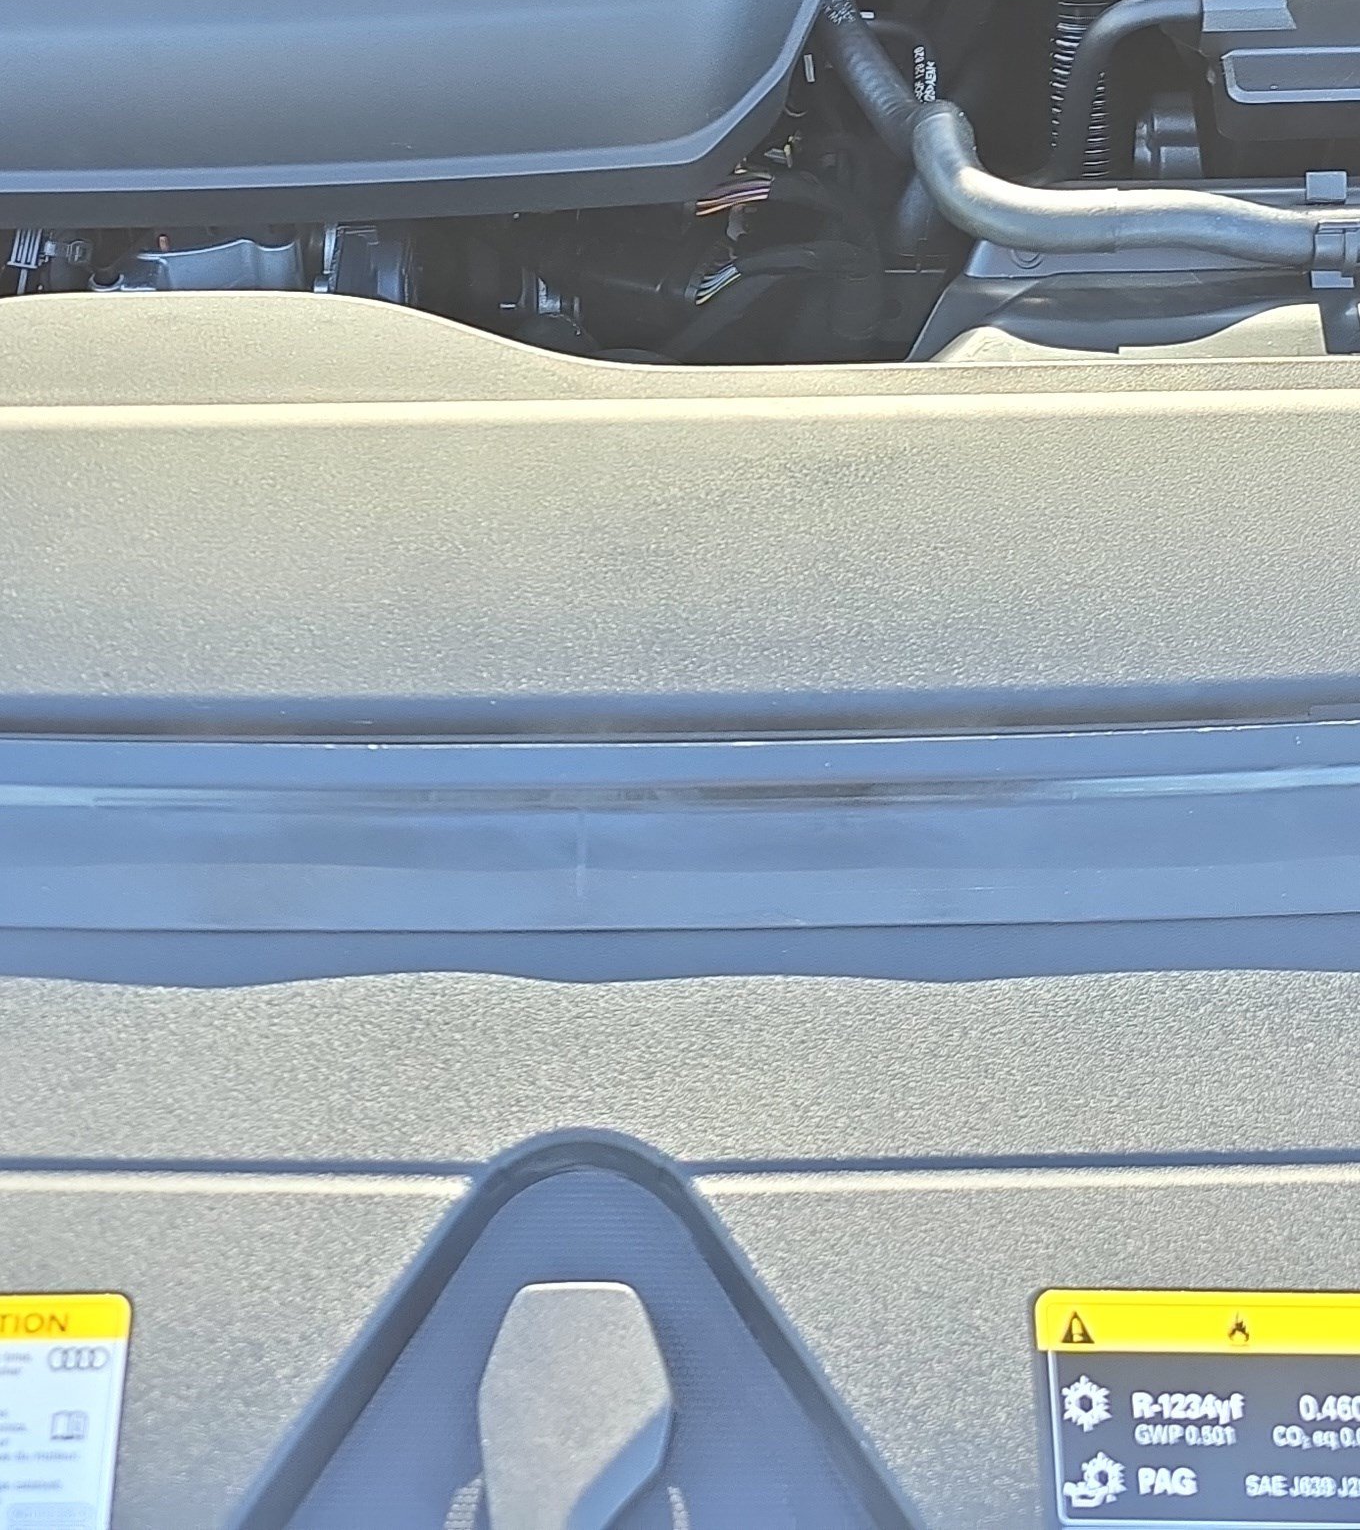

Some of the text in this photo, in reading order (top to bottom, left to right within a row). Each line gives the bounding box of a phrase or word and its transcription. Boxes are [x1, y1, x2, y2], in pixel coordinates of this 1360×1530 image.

[1131, 1391, 1246, 1425] R-1234yf
[1134, 1423, 1184, 1446] GWP
[1311, 1430, 1341, 1451] eq
[1137, 1466, 1198, 1496] PAG
[1244, 1474, 1289, 1497] SAE
